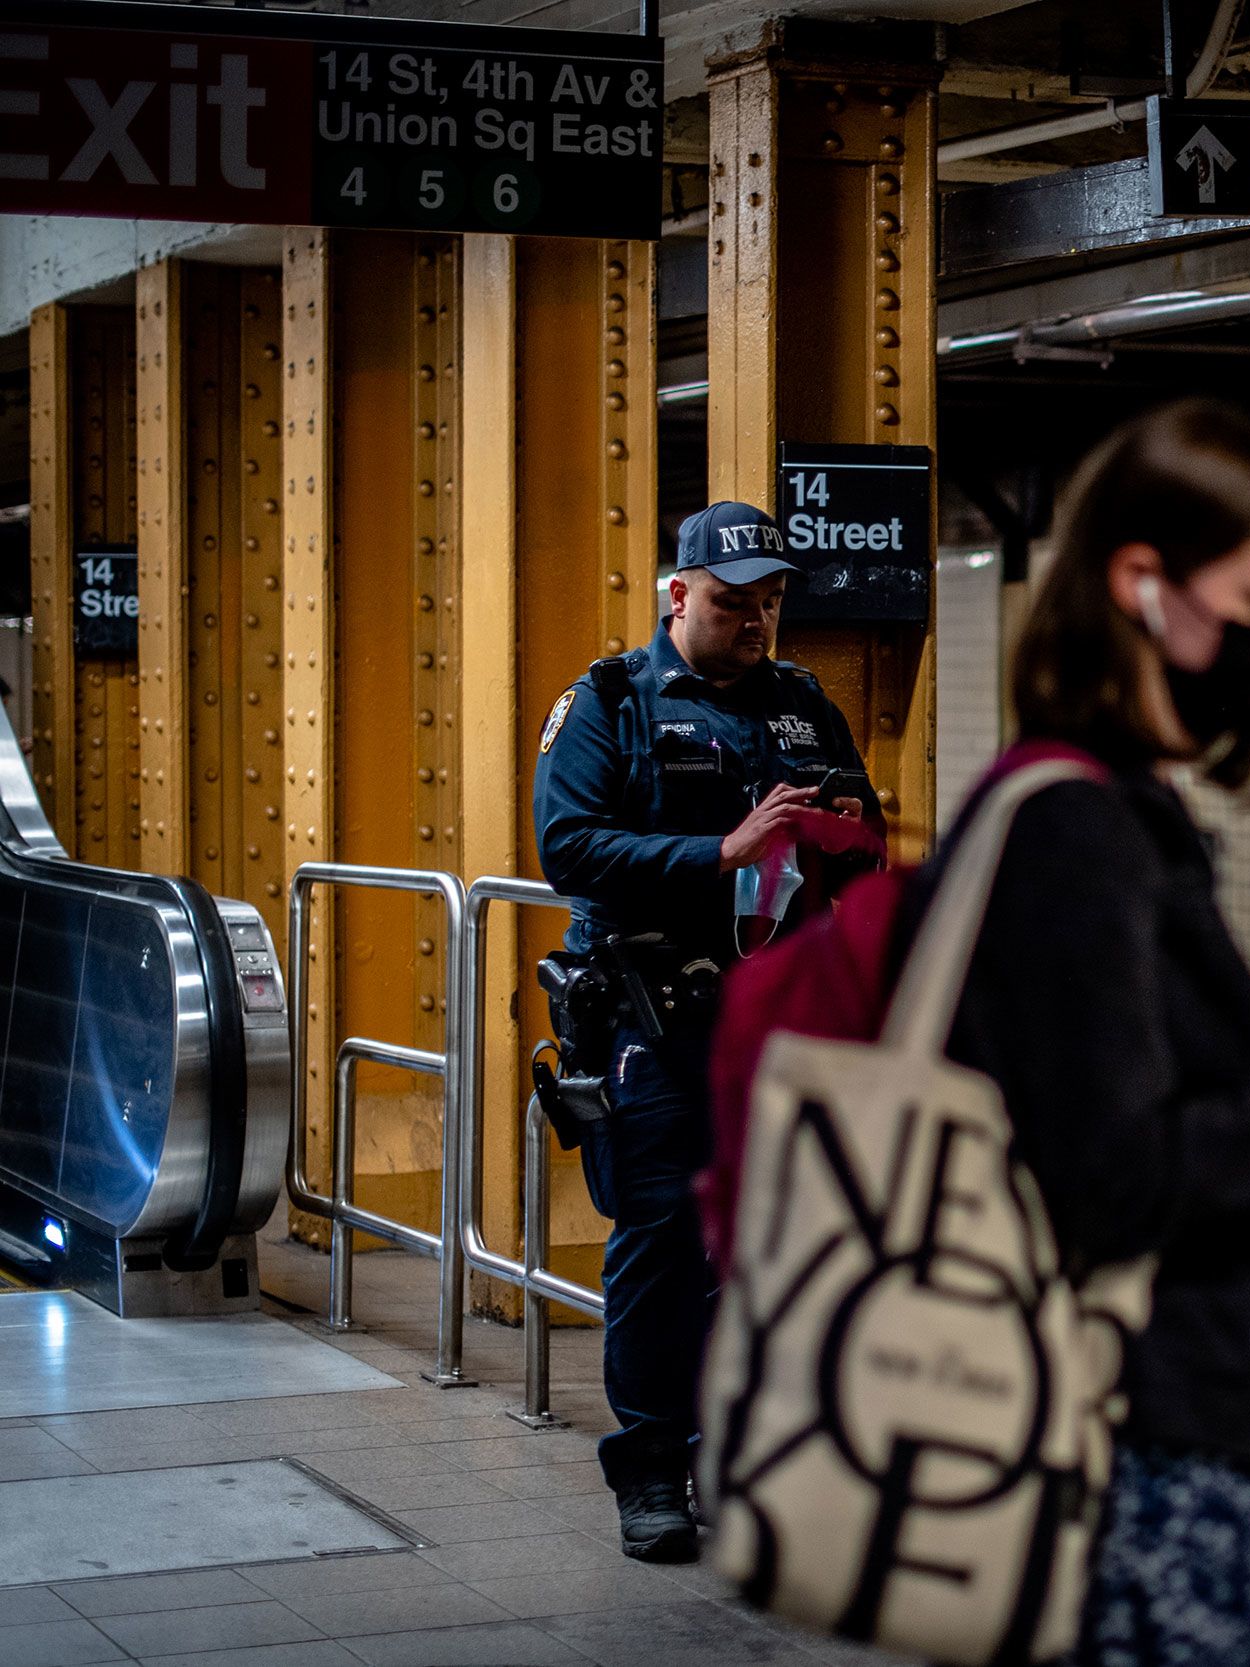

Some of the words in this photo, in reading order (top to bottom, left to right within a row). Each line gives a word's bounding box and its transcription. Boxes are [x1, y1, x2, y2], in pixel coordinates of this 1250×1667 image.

[319, 50, 373, 92] 14
[388, 53, 448, 104] St,
[462, 58, 534, 102] 4th
[550, 64, 610, 106] Av
[625, 68, 657, 108] &
[0, 33, 267, 190] Exit
[318, 101, 457, 148] Union
[474, 107, 535, 161] Sq
[552, 113, 653, 158] East
[340, 167, 367, 206] 4
[418, 170, 444, 209] 5
[492, 174, 520, 213] 6
[788, 472, 830, 507] 14
[718, 524, 784, 553] NYPD
[788, 513, 904, 551] Street
[80, 558, 114, 586] 14
[767, 720, 816, 737] POLICE
